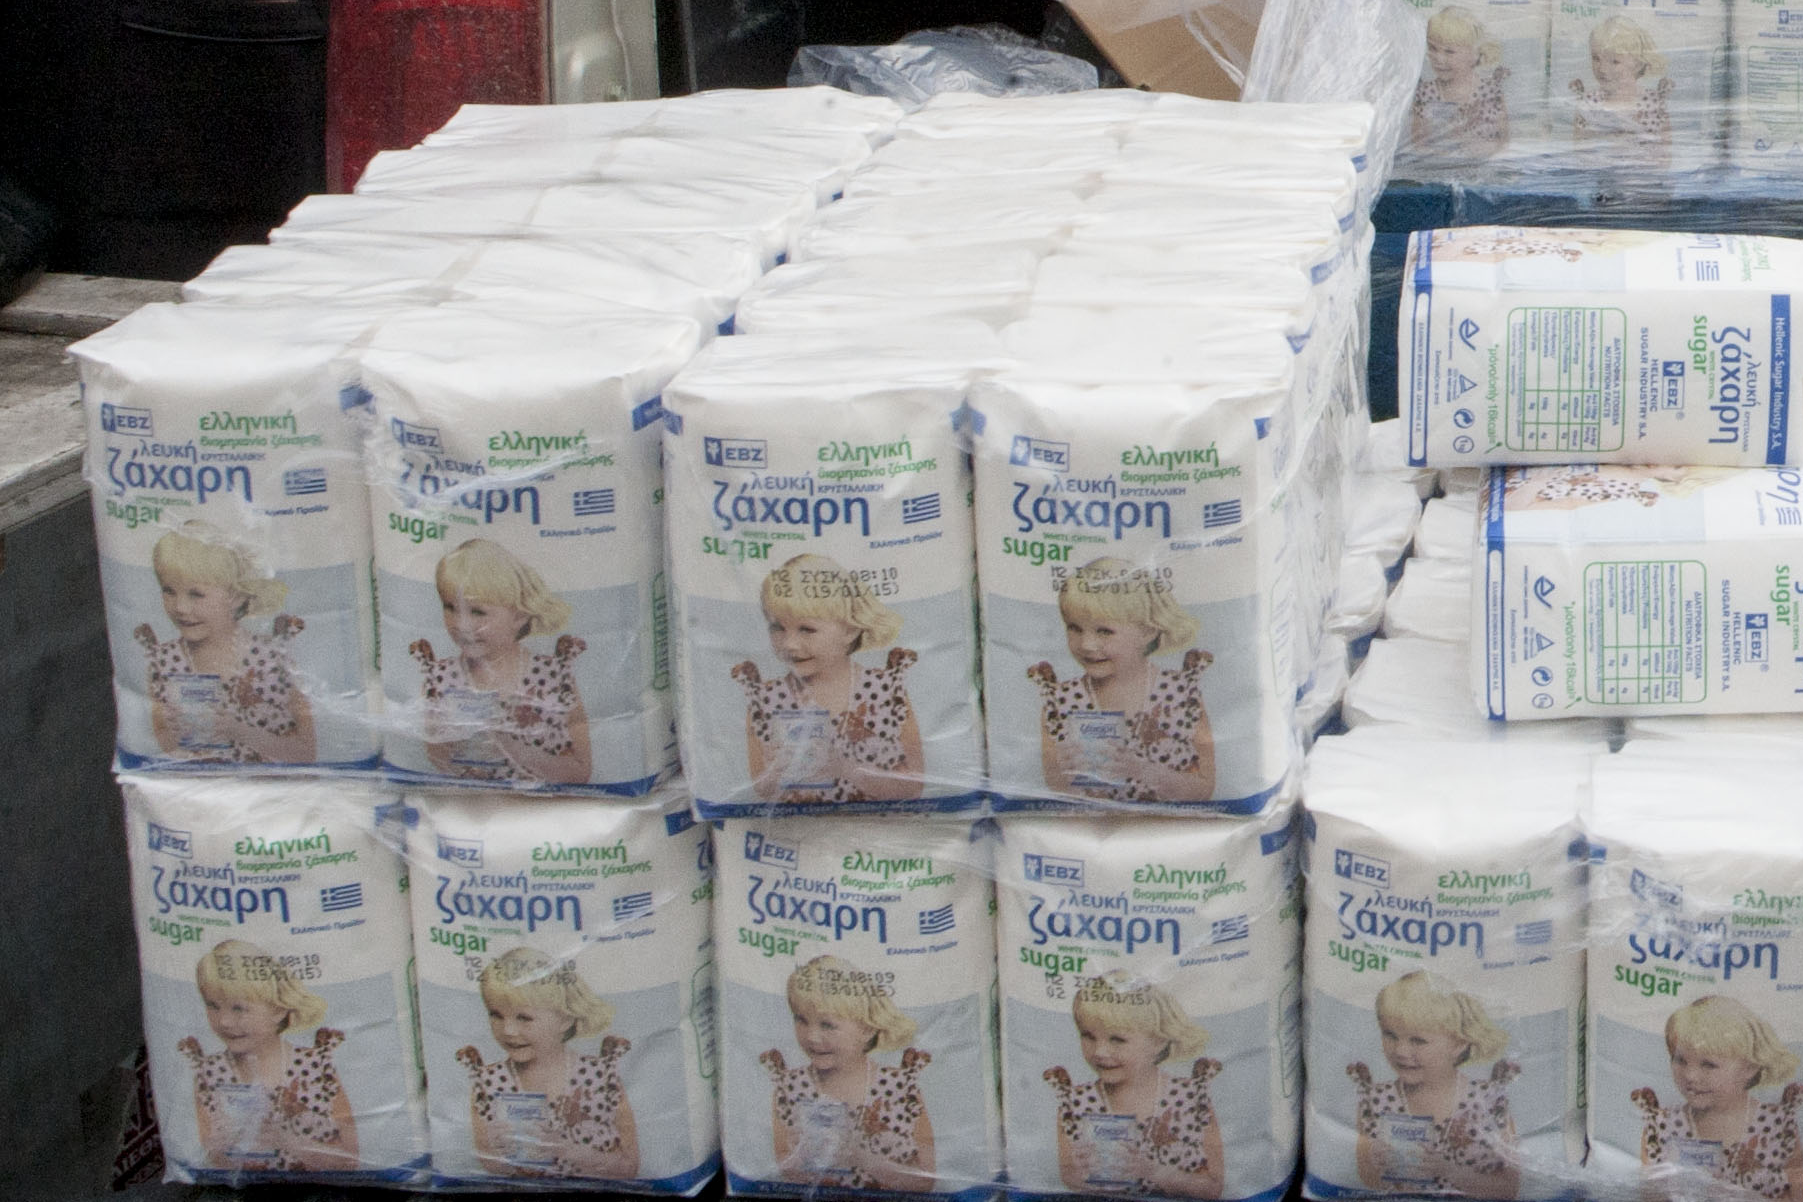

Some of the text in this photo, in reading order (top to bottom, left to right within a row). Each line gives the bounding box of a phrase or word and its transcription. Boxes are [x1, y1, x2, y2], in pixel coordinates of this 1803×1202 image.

[1687, 315, 1708, 375] sugar
[1774, 317, 1785, 356] Hellenic
[1708, 326, 1752, 444] ζάχαρη
[1742, 362, 1762, 407] λευκή
[1773, 357, 1785, 389] Sugar
[200, 410, 297, 435] ελληνική
[140, 439, 197, 463] λευκή
[488, 430, 589, 455] ελληνική
[817, 436, 912, 466] ελληνική
[1121, 440, 1219, 470] ελληνική
[107, 447, 253, 502] ζάχαρη
[750, 472, 814, 497] λευκή
[1053, 475, 1117, 500] λευκή
[106, 499, 163, 529] sugar
[713, 481, 870, 536] ζάχαρη
[1012, 482, 1171, 539] ζάχαρη
[388, 511, 450, 543] sugar
[1003, 536, 1072, 565] sugar
[1770, 565, 1790, 626] sugar
[235, 828, 331, 855] ελληνική
[531, 840, 628, 865] ελληνική
[180, 861, 235, 884] λευκή
[466, 871, 529, 895] λευκή
[782, 871, 838, 900] λευκή
[1133, 861, 1227, 888] ελληνική
[1437, 870, 1532, 893] ελληνική
[153, 866, 290, 923] ζάχαρη
[436, 874, 582, 931] ζάχαρη
[748, 875, 888, 943] ζάχαρη
[149, 915, 204, 947] sugar
[430, 924, 489, 955] sugar
[1028, 897, 1181, 955] ζάχαρη
[1337, 890, 1484, 958] ζάχαρη
[738, 926, 800, 958] sugar
[1328, 940, 1390, 973] sugar
[1020, 945, 1088, 978] sugar
[1614, 963, 1684, 998] sugar
